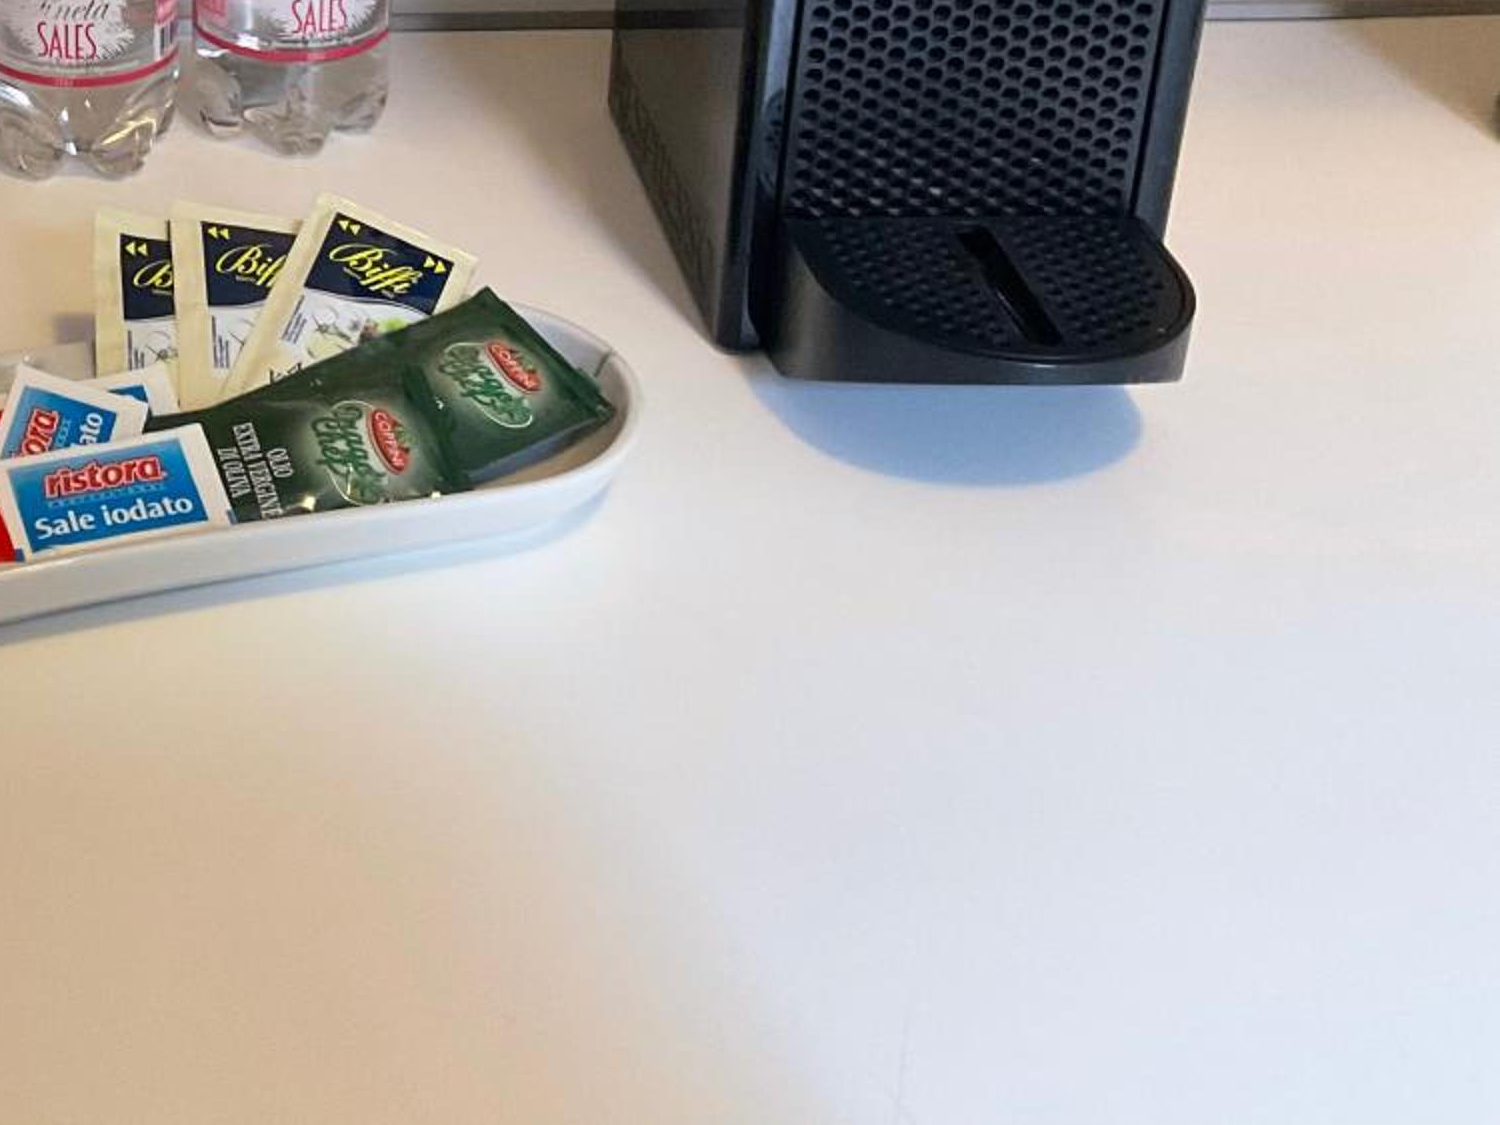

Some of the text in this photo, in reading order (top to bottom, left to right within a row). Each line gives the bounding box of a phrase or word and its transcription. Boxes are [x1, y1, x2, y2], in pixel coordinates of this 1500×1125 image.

[37, 20, 98, 60] SALES
[44, 455, 164, 499] ristora
[34, 496, 194, 540] Sale iodato
